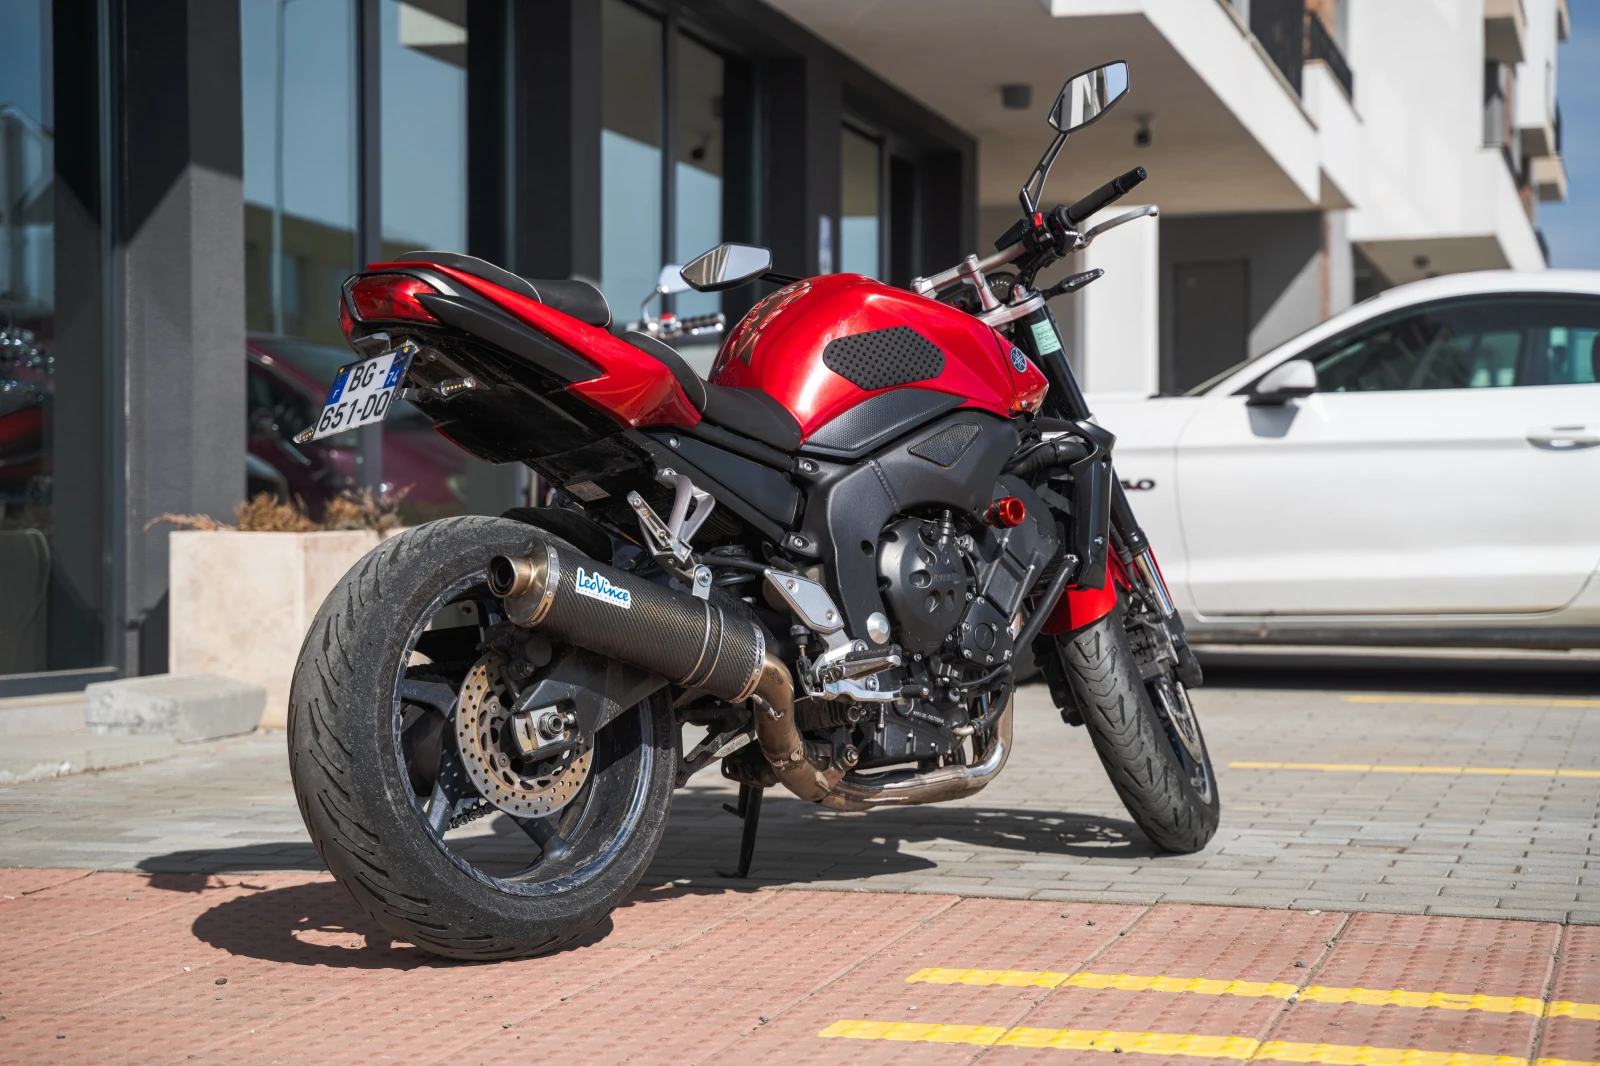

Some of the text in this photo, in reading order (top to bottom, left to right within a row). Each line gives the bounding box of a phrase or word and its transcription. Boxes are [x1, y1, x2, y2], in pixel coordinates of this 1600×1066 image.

[386, 369, 399, 385] 74
[332, 389, 339, 399] F
[320, 391, 390, 432] 651-DQ
[578, 570, 629, 601] LeoVince
